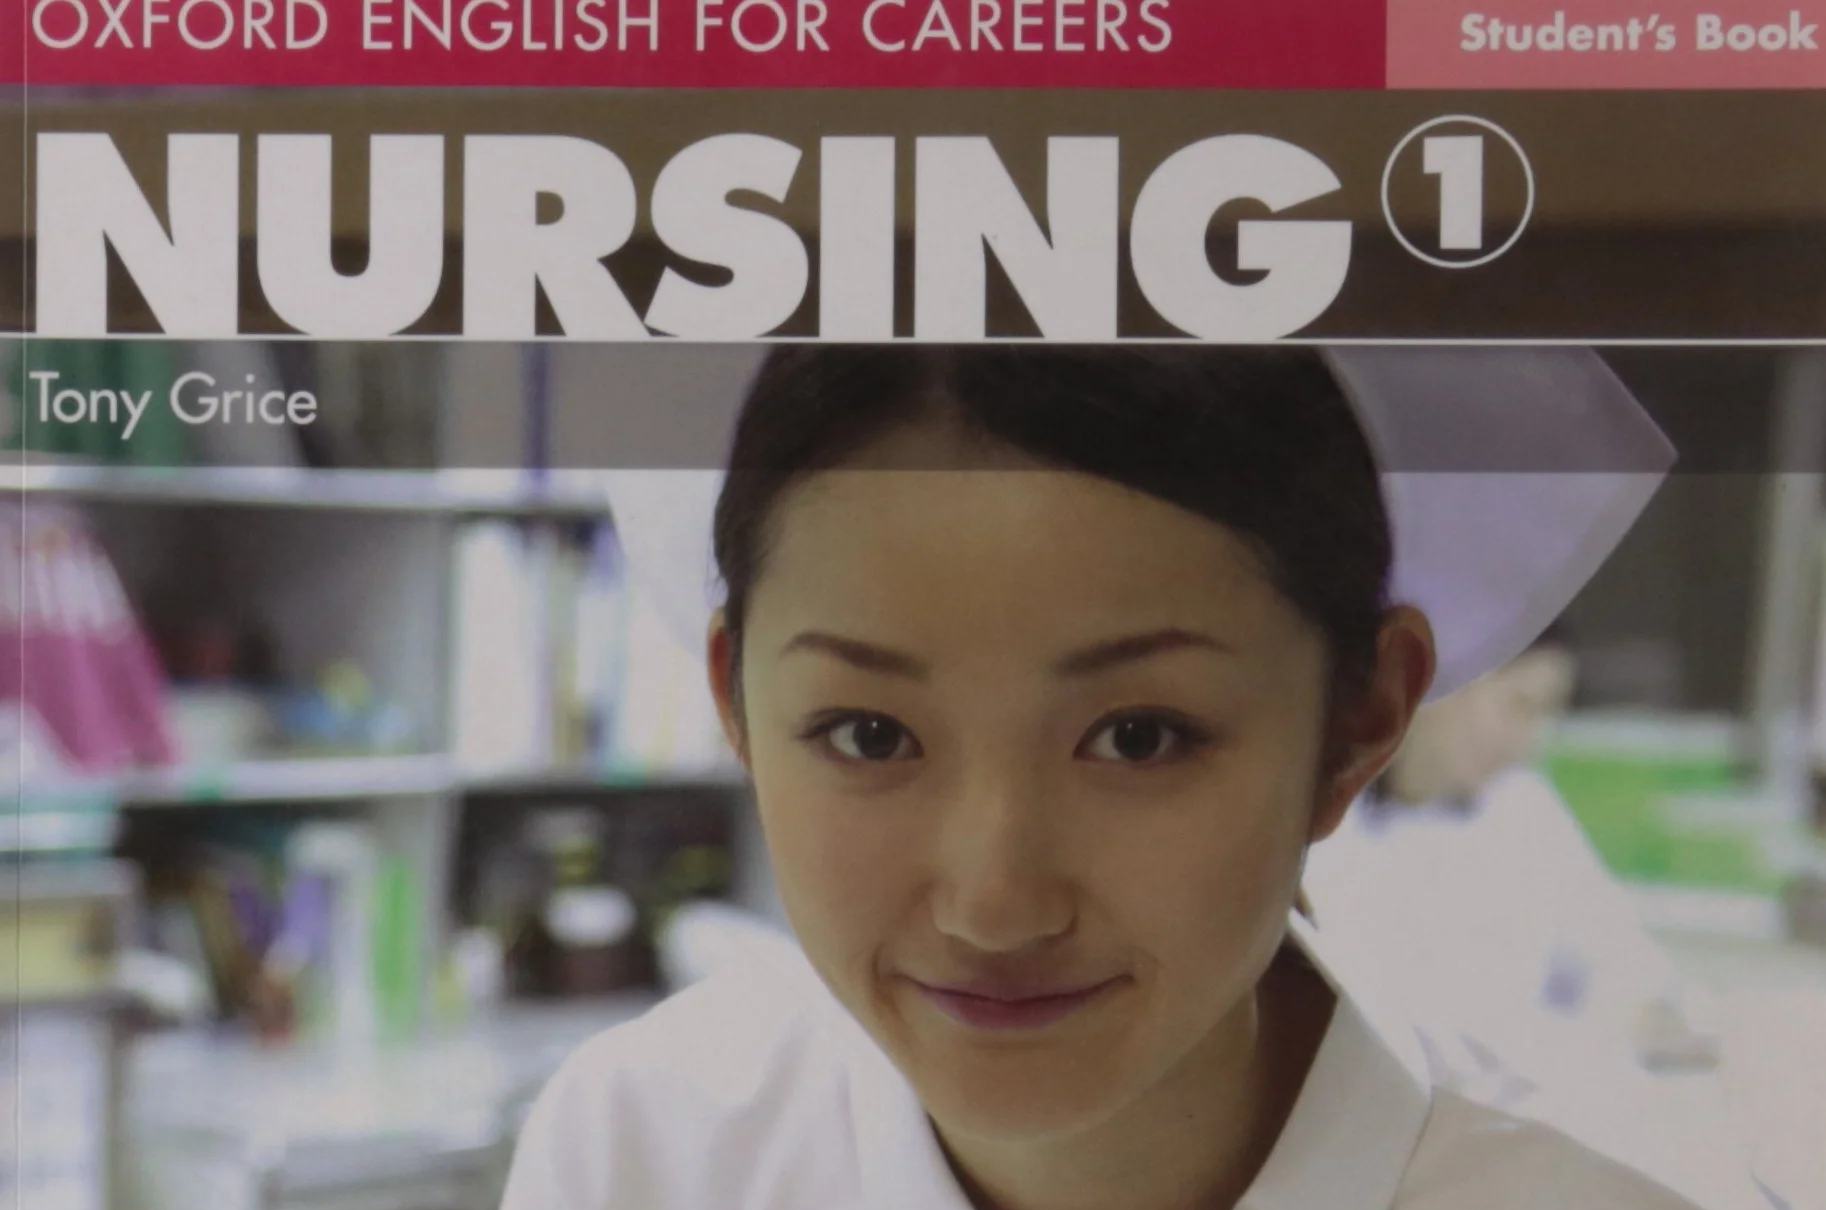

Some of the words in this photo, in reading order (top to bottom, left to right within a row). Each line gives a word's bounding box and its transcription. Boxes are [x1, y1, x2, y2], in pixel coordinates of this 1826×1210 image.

[32, 0, 328, 51] OXFORD
[363, 0, 659, 52] ENGLISH
[696, 0, 830, 53] FOR
[862, 0, 1172, 53] CAREERS
[1459, 11, 1676, 51] Student's
[1696, 10, 1819, 50] Book
[1423, 136, 1483, 249] 1
[36, 132, 1352, 338] NURSING
[30, 371, 152, 439] Tony
[170, 371, 318, 425] Grice
